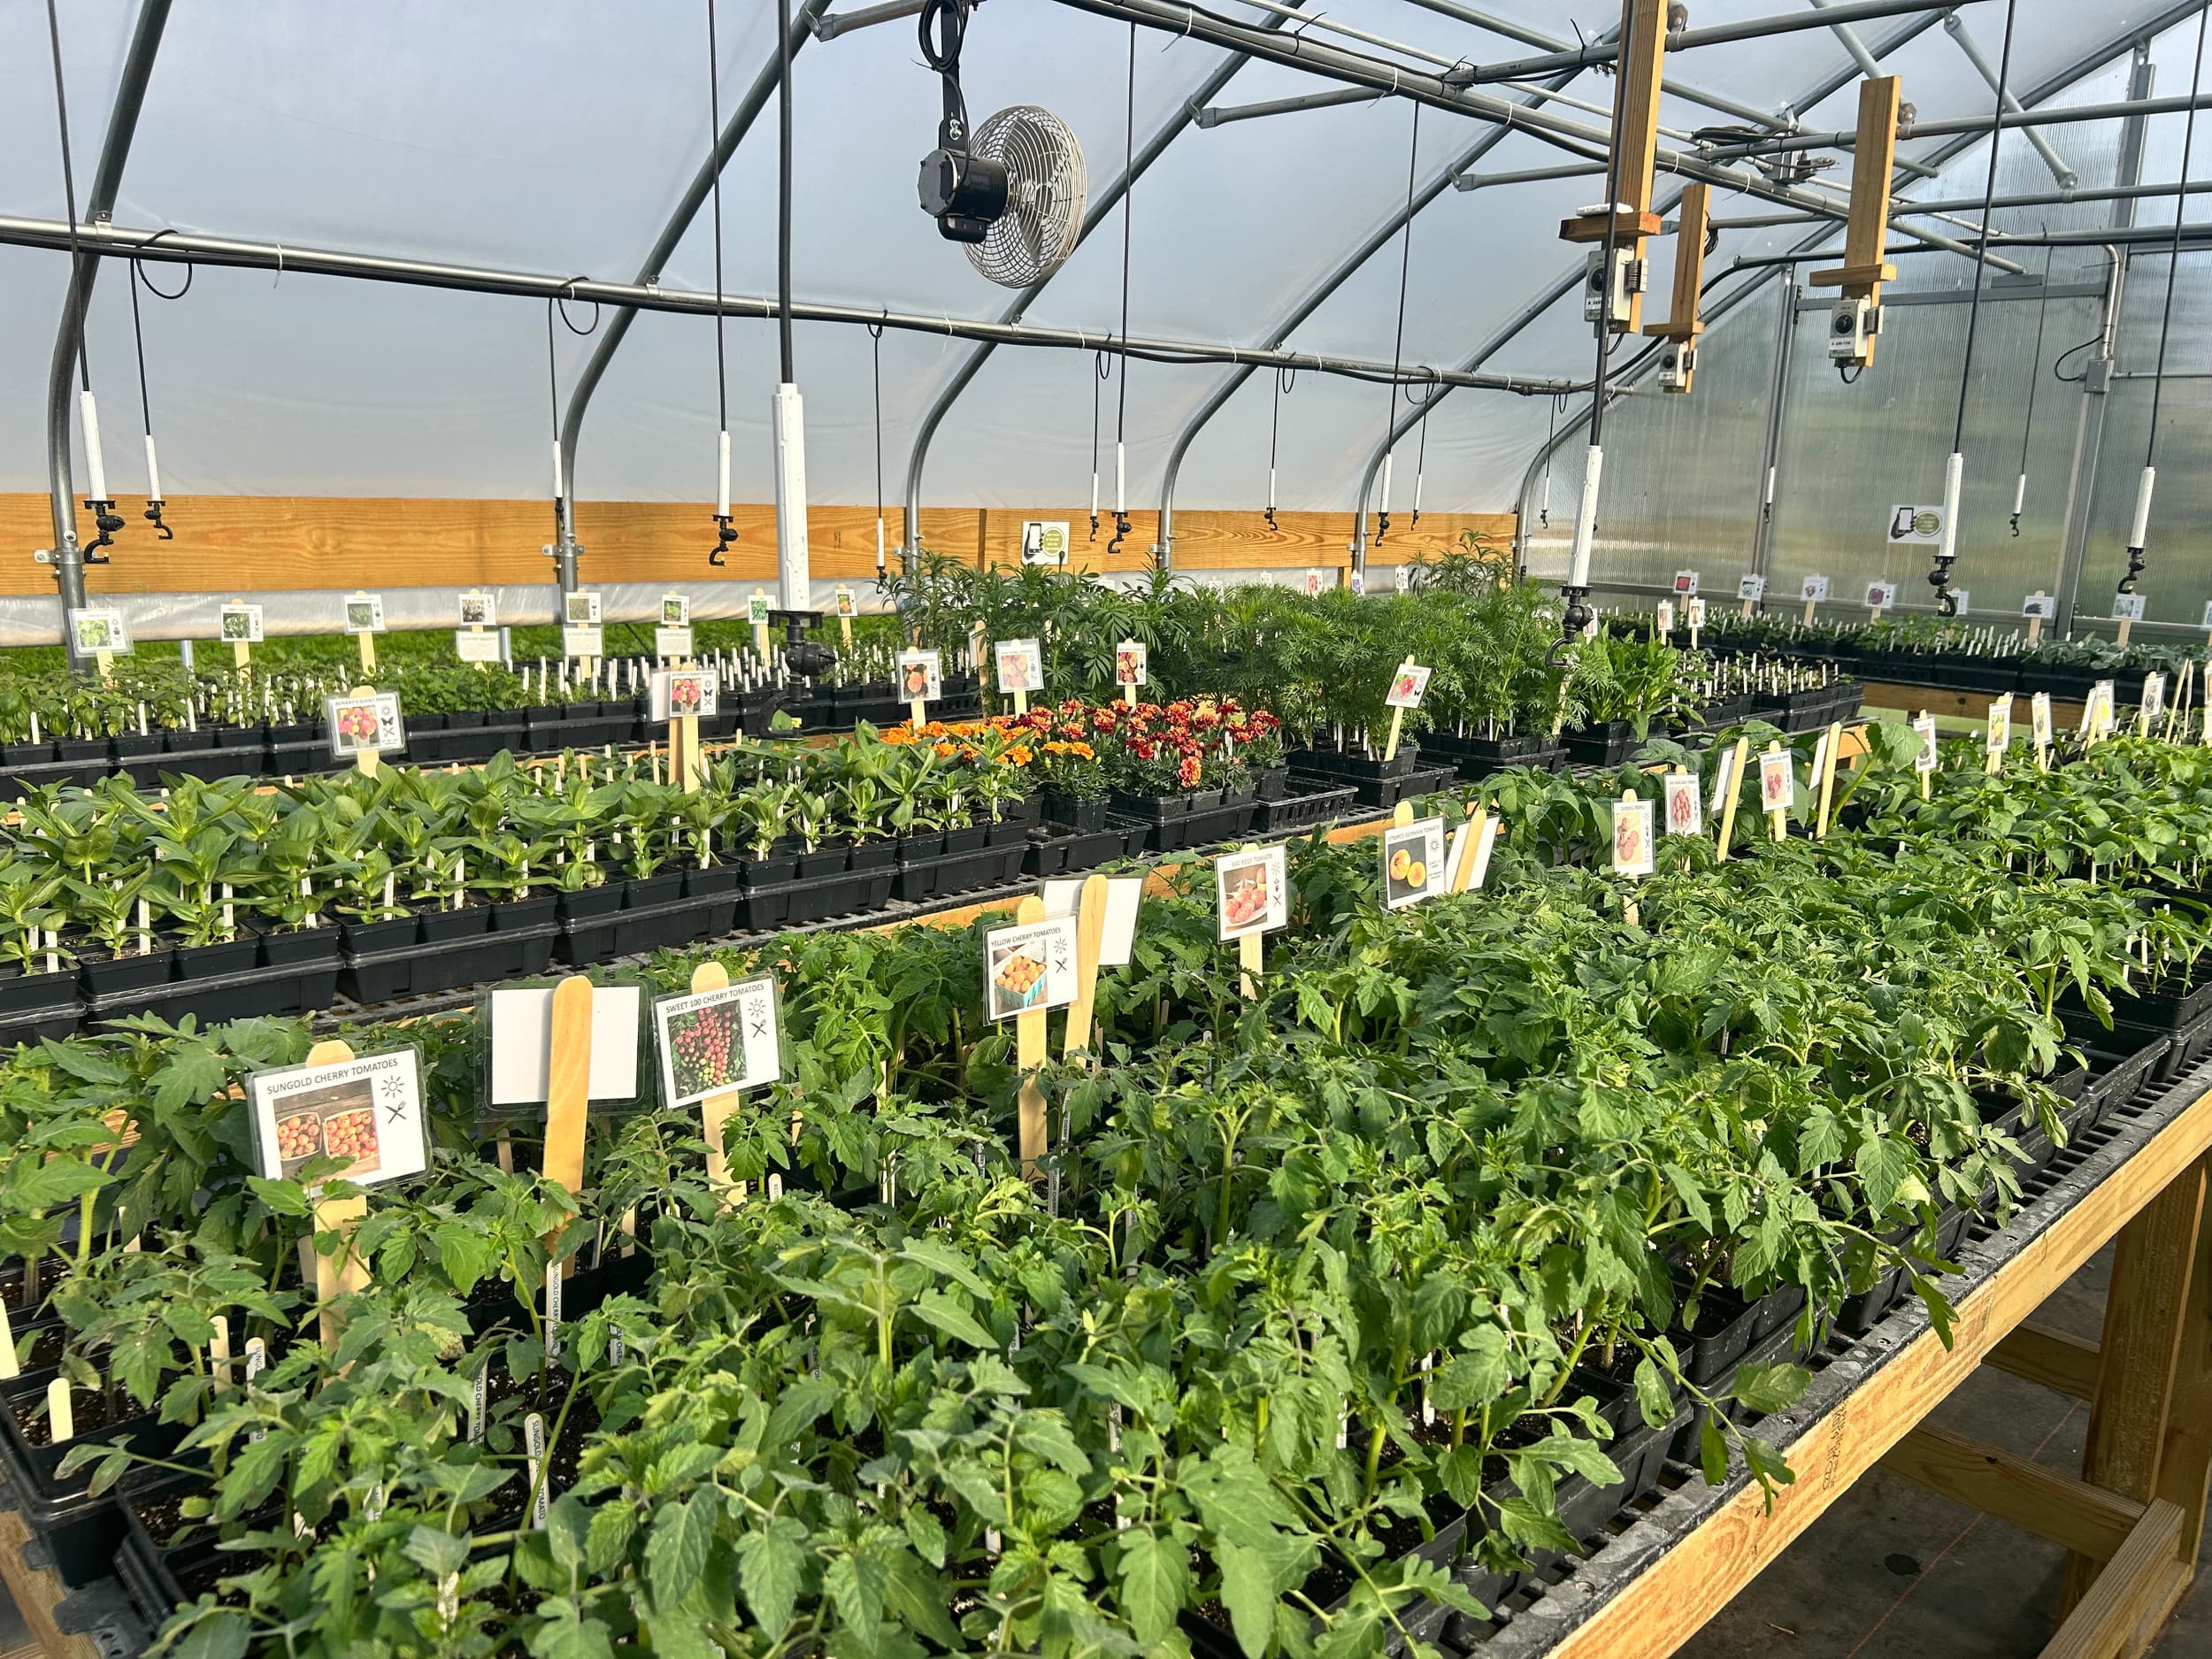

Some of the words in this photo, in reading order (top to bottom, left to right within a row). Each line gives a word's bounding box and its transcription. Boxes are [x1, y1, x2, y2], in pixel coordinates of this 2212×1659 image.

[991, 938, 1011, 948] YELLOW
[1012, 933, 1032, 942] CHERRY
[1033, 927, 1062, 938] TOMATOES
[665, 1001, 688, 1014] SWEET
[690, 998, 702, 1007] 100
[703, 993, 728, 1004] CHERRY
[729, 983, 764, 997] TOMATOES
[267, 1076, 312, 1094] SUNGOLD
[314, 1069, 349, 1084] CHERRY
[351, 1058, 398, 1076] TOMATOES
[533, 1419, 541, 1456] SUNGOLD
